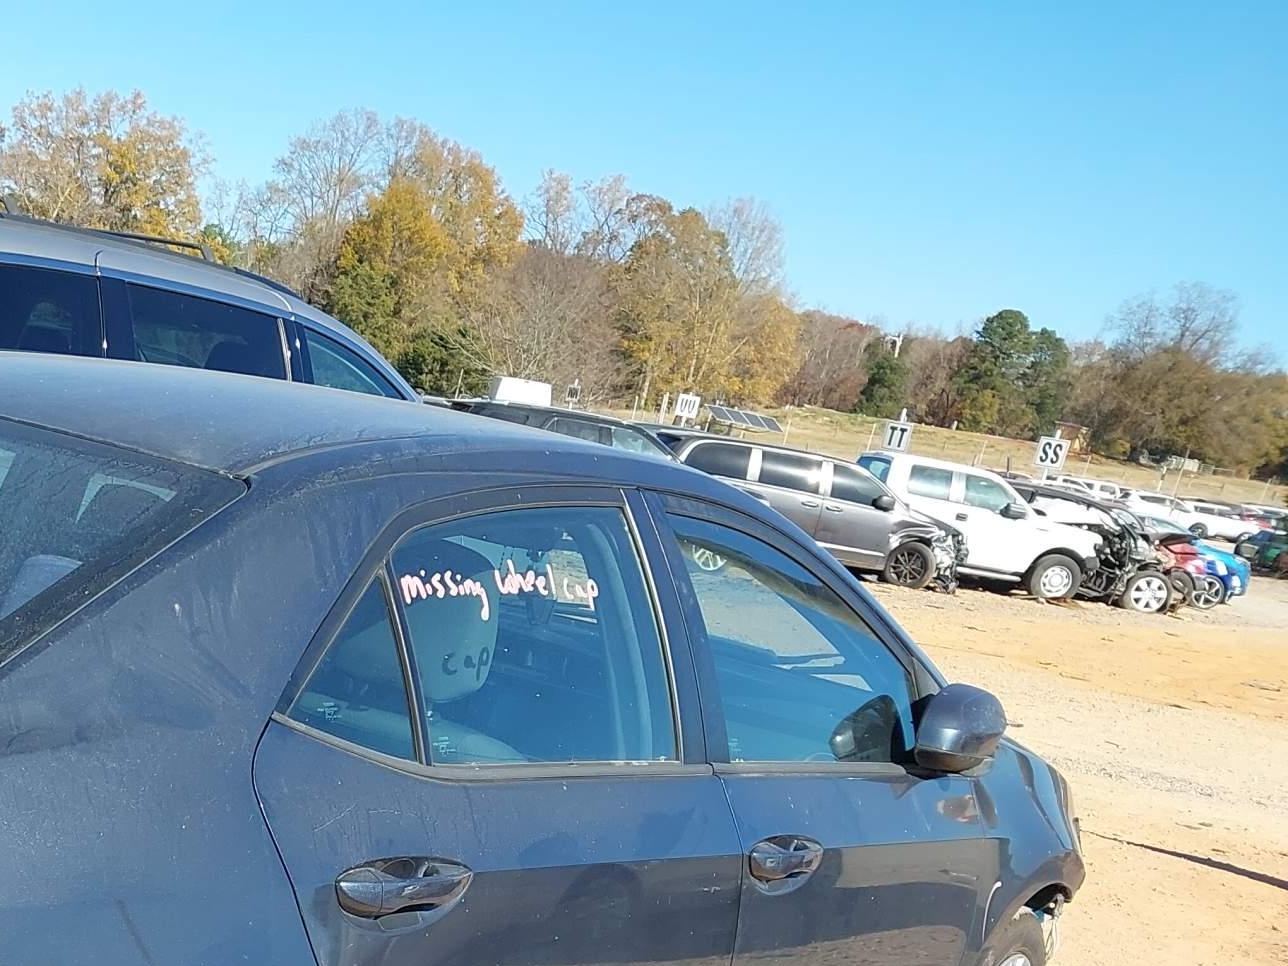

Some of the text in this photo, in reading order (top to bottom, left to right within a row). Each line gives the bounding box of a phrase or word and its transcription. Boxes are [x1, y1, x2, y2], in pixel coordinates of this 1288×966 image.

[887, 425, 909, 448] TT
[1039, 441, 1063, 465] SS
[400, 568, 491, 621] missing
